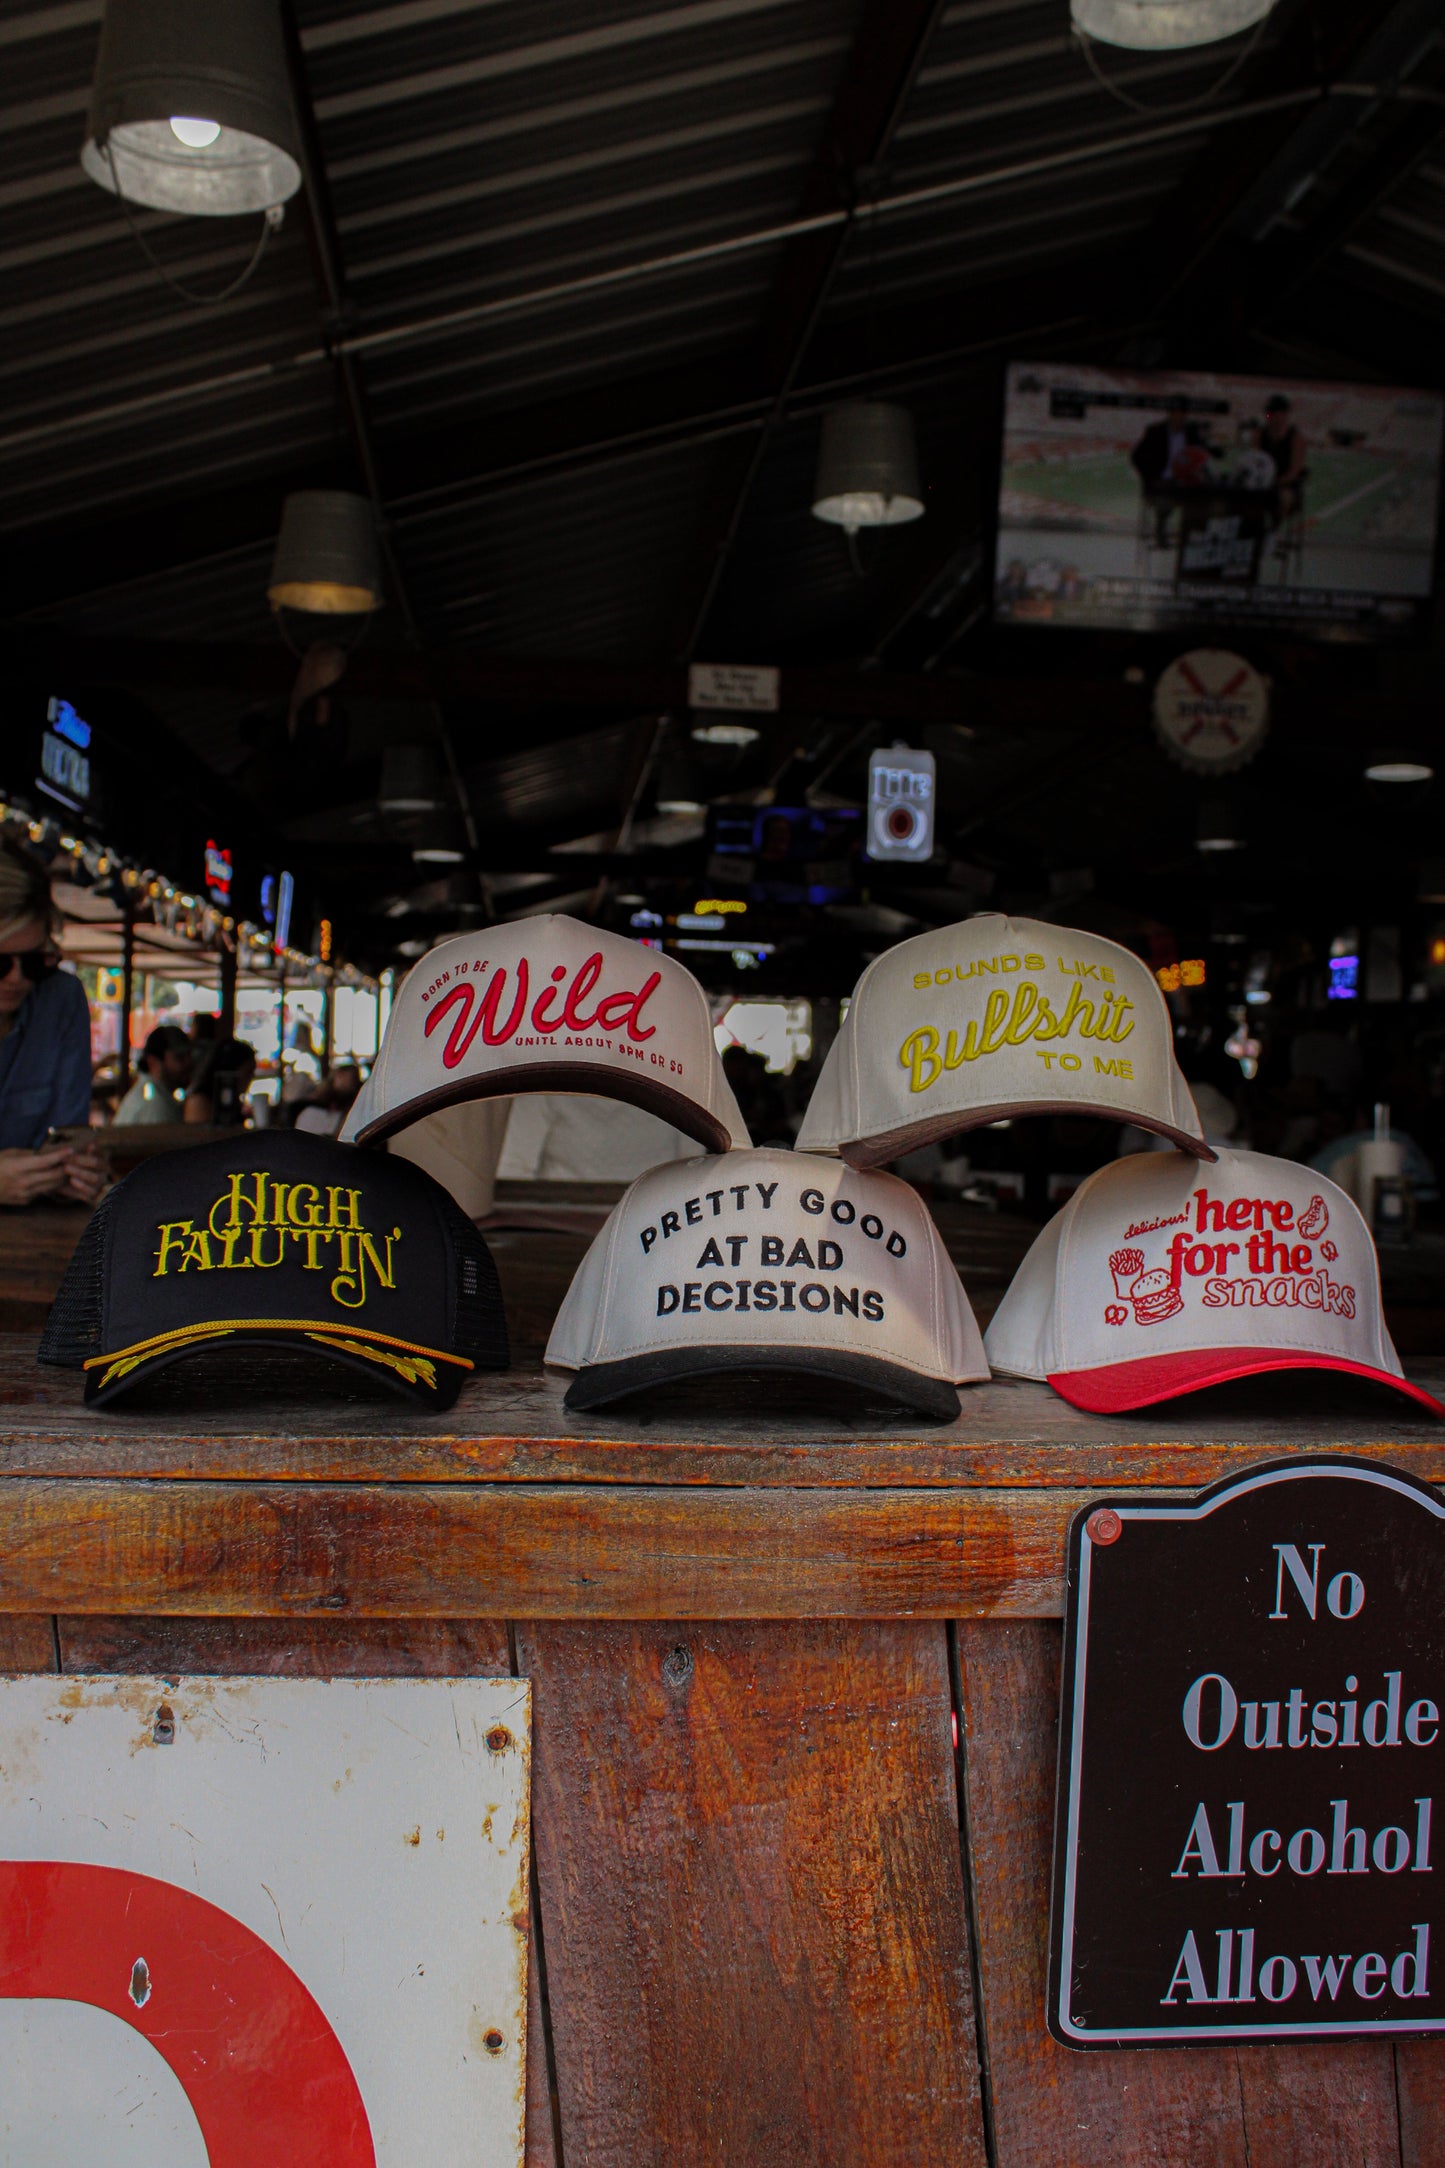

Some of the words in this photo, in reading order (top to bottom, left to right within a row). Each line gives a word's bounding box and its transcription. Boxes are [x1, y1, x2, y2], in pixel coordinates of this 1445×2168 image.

[421, 971, 450, 1002] BORN
[454, 961, 469, 976] TO
[473, 959, 489, 972] BE
[913, 953, 1046, 989] SOUNDS
[1057, 956, 1116, 984] LIKE
[424, 951, 661, 1070] Wild
[899, 980, 1135, 1093] Bullshit
[515, 1036, 558, 1047] UNITL
[564, 1036, 613, 1049] ABOUT
[650, 1052, 666, 1069] OR
[670, 1059, 684, 1076] SO
[1036, 1051, 1082, 1071] TO
[1093, 1056, 1135, 1081] ME
[208, 1171, 365, 1242] HIGH
[639, 1182, 779, 1255] PRETTY
[799, 1188, 907, 1259] GOOD
[1123, 1201, 1191, 1241] delicious!
[1193, 1188, 1295, 1234] here
[152, 1219, 402, 1308] FALUTIN'
[696, 1235, 748, 1270] AT
[760, 1235, 844, 1271] BAD
[1166, 1232, 1240, 1290] for
[1245, 1230, 1313, 1275] the
[656, 1280, 885, 1322] DECISIONS
[1202, 1268, 1356, 1320] snacks
[1268, 1543, 1366, 1621] No
[1182, 1671, 1440, 1751] Outside
[1171, 1798, 1433, 1878] Alcohol
[1159, 1923, 1430, 2006] Allowed
